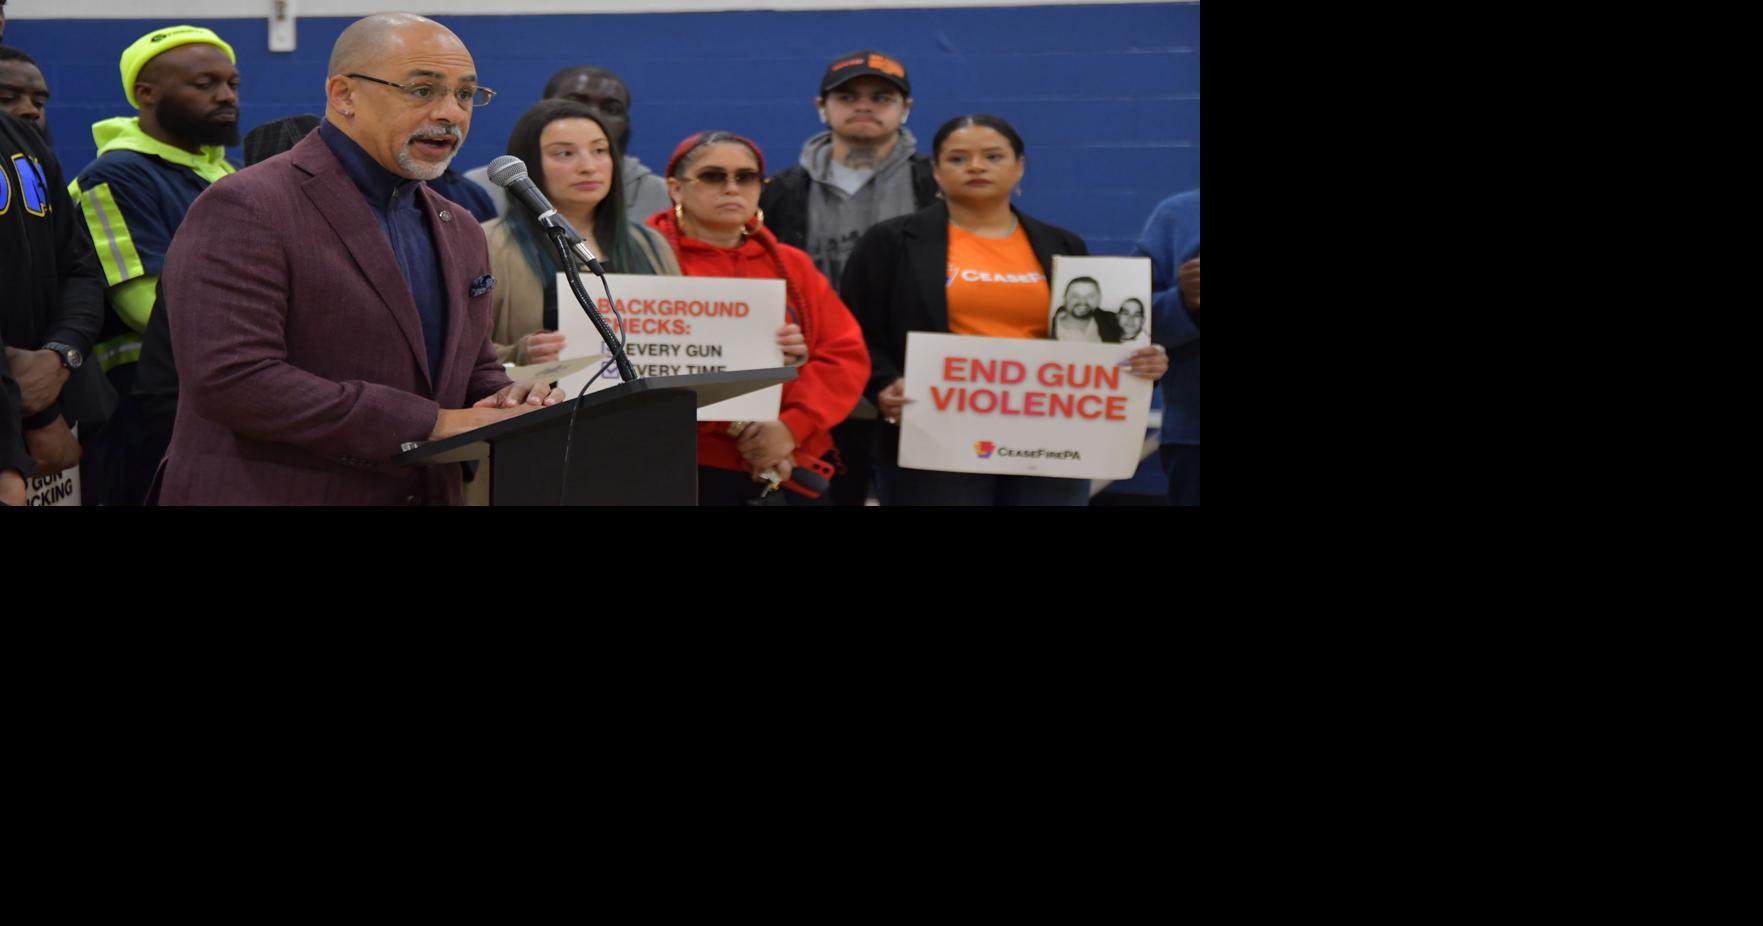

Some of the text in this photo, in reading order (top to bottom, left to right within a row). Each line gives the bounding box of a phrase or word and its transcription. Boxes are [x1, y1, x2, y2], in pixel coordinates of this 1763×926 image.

[597, 298, 750, 318] BACKGROUND
[626, 343, 722, 357] EVERY GUN
[633, 364, 681, 376] VERY
[943, 357, 1120, 390] END GUN
[930, 386, 1128, 421] VIOLENCE
[32, 470, 62, 490] GUN
